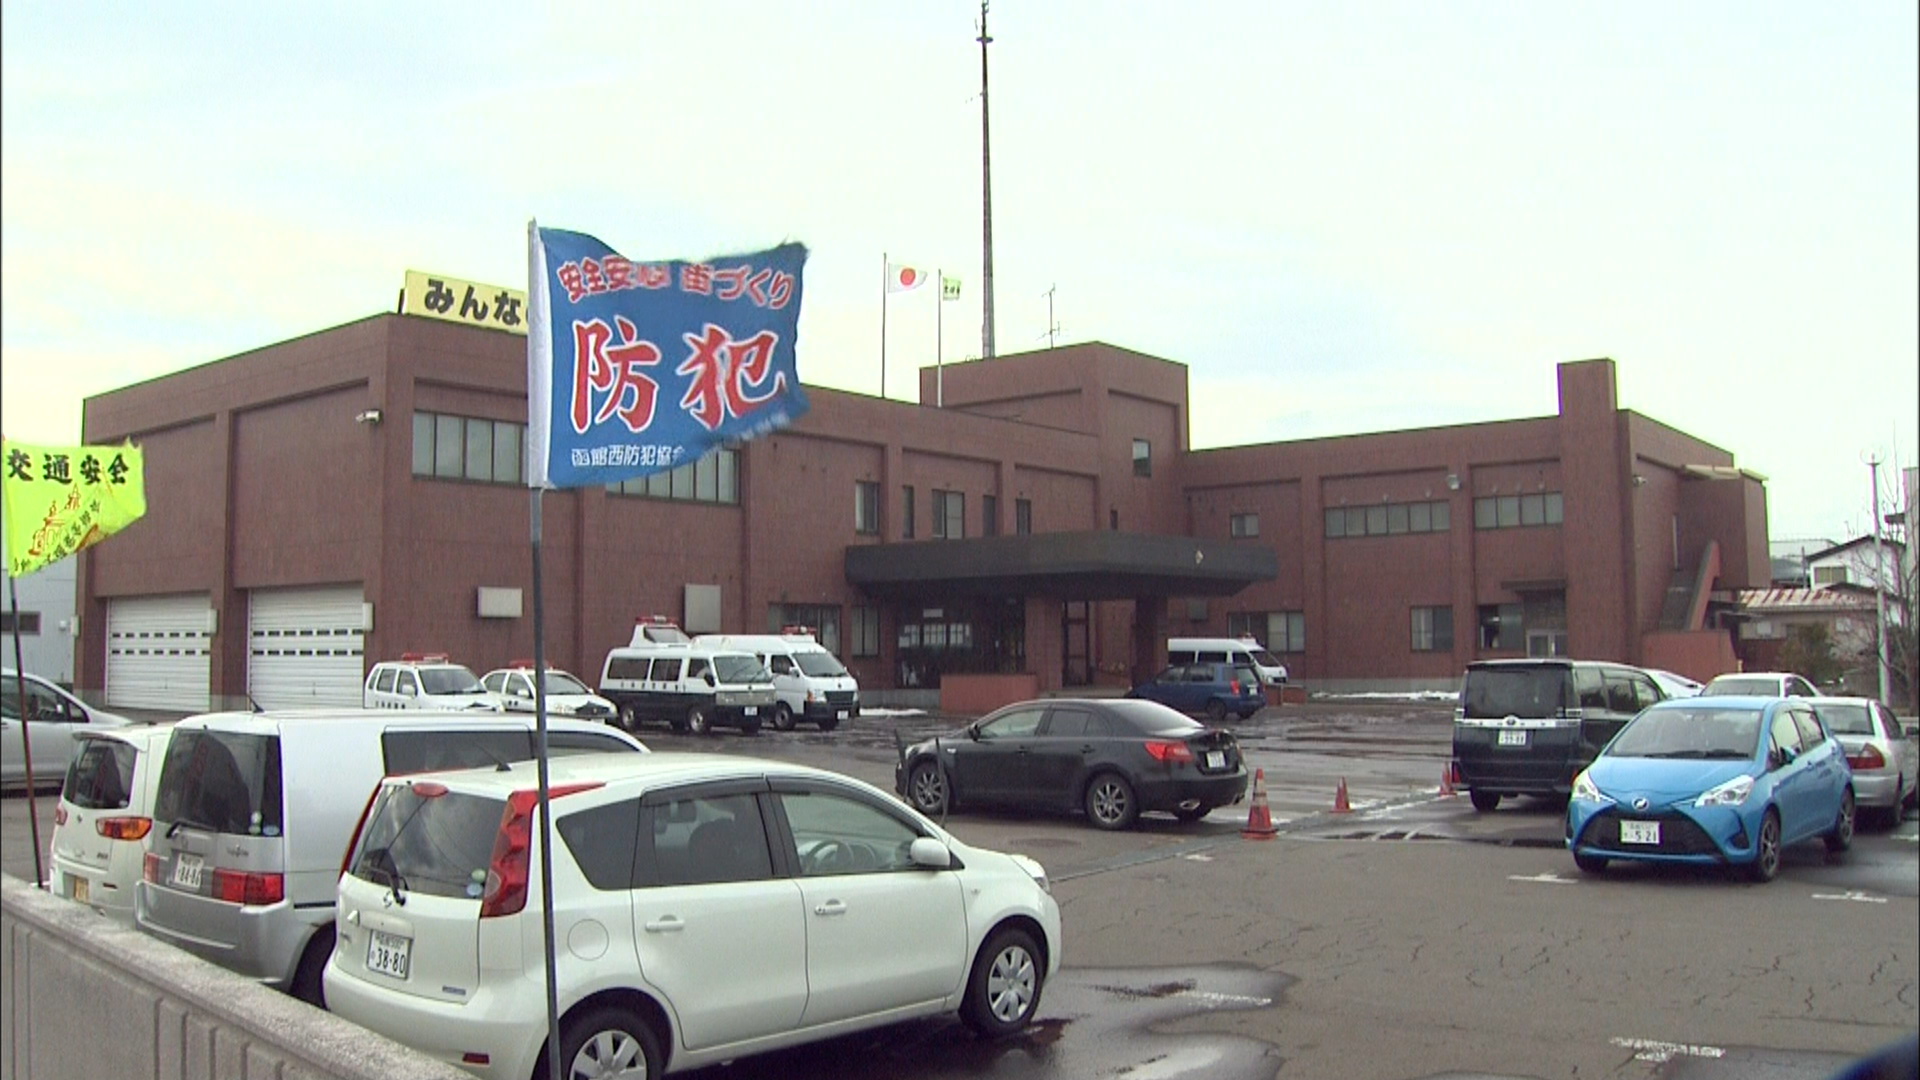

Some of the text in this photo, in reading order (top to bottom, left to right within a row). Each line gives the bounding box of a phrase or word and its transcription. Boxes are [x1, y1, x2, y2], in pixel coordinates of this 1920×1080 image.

[424, 278, 528, 327] みんな
[557, 256, 794, 310] 安全安心 街づくり
[571, 314, 786, 434] 防犯
[7, 448, 130, 486] 交通安全
[376, 947, 406, 974] 38-80
